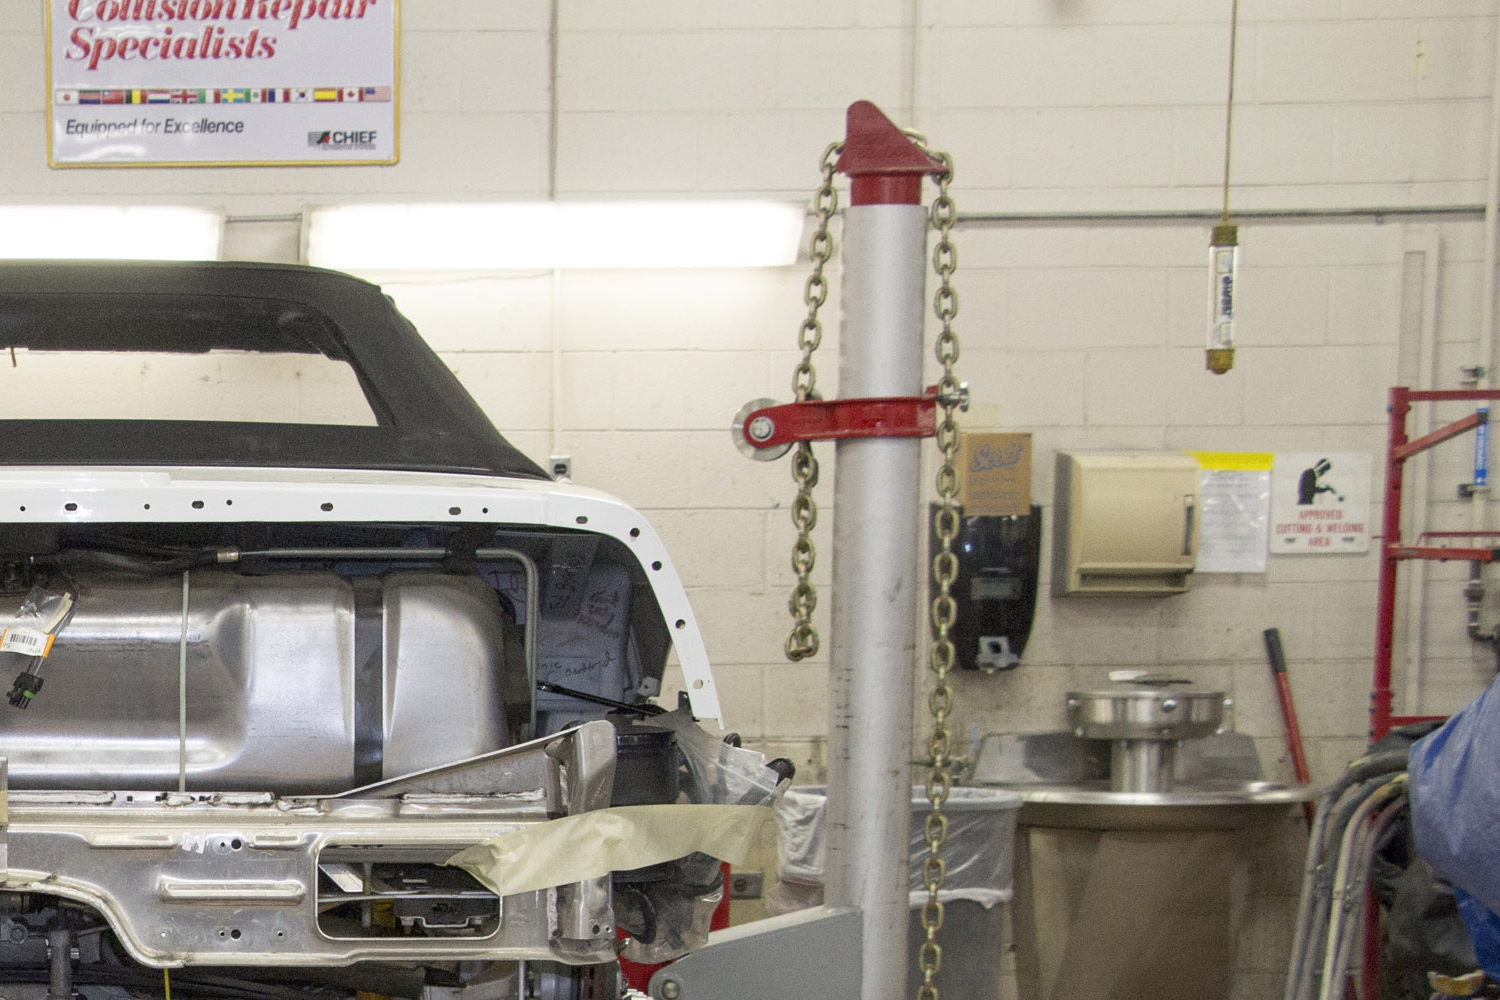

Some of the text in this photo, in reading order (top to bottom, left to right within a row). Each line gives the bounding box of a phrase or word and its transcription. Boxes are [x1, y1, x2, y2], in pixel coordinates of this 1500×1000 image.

[65, 26, 277, 70] Specialists
[66, 118, 244, 138] Equipped for Excellence
[333, 131, 377, 145] CHIEF
[1299, 510, 1342, 520] APPROVED
[1275, 524, 1311, 534] CUTTING
[1327, 523, 1364, 533] WELDING
[1308, 537, 1331, 547] AREA
